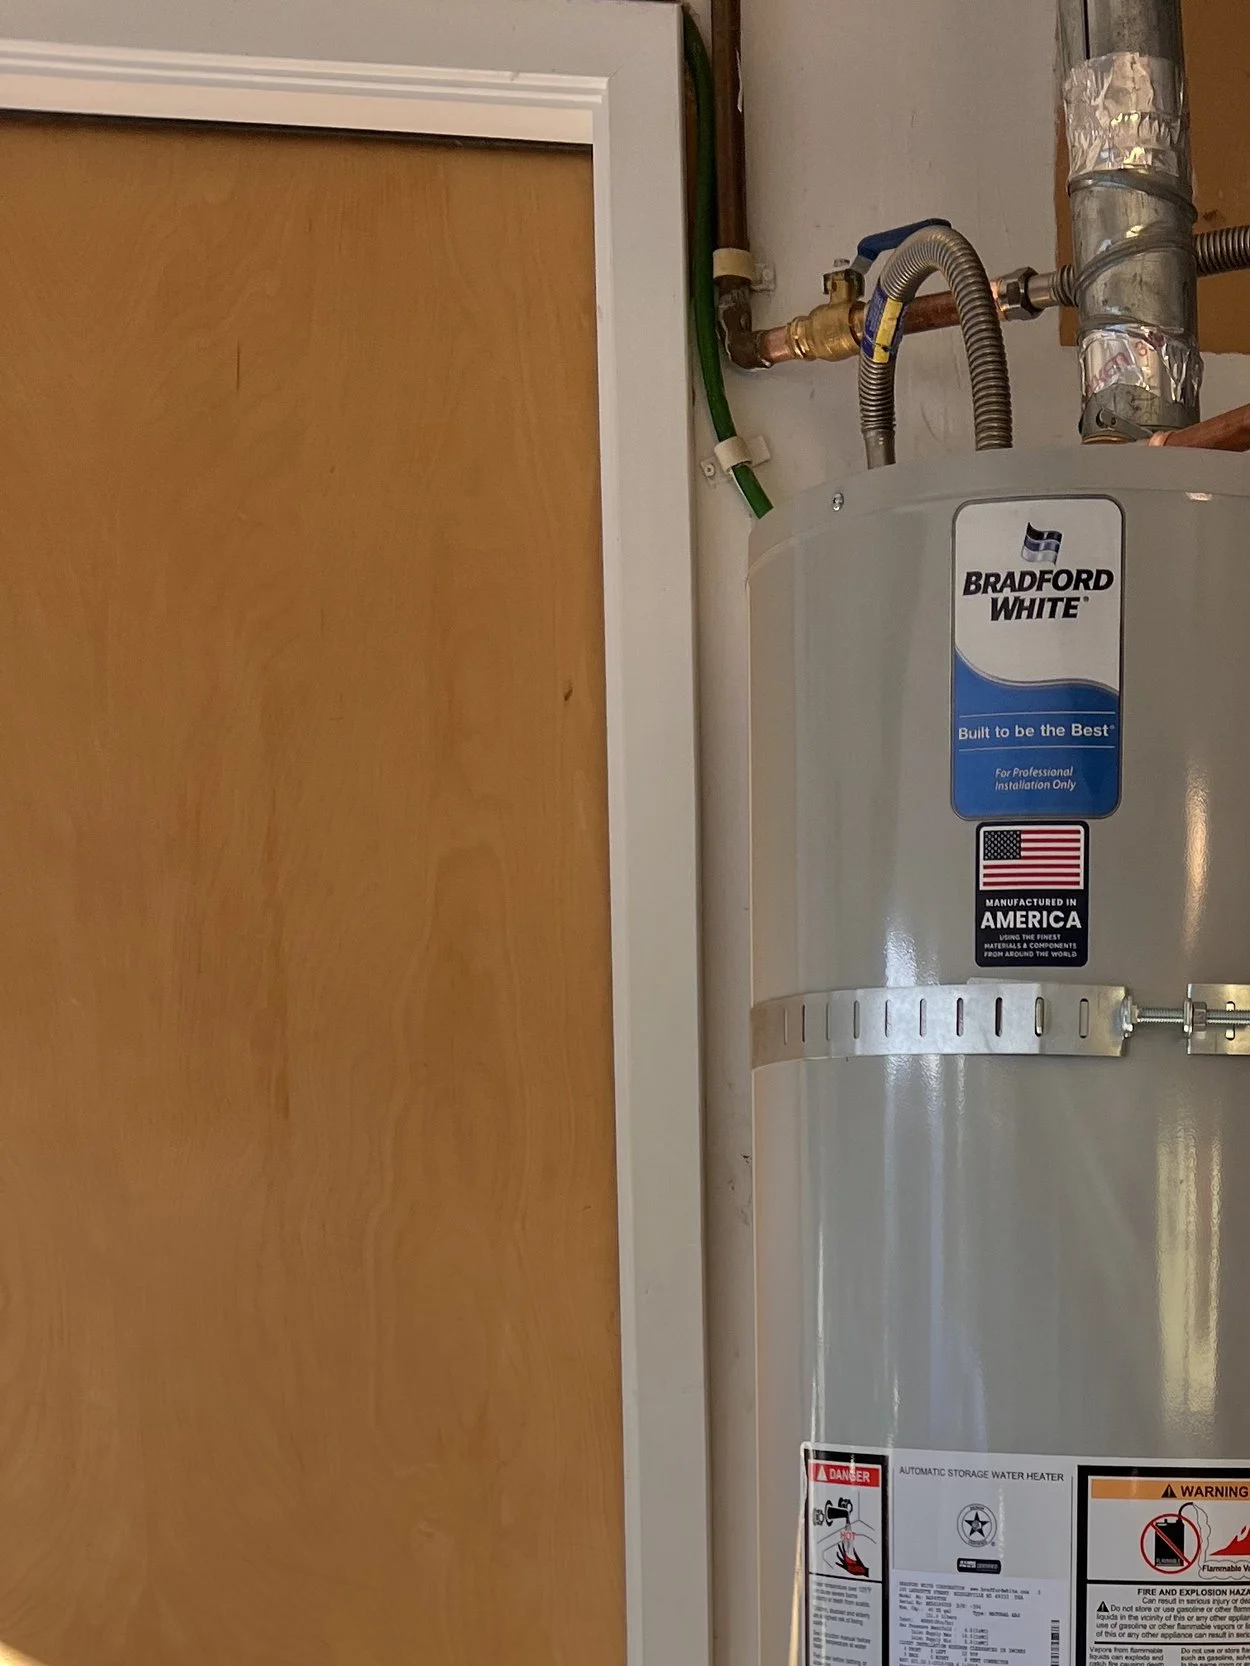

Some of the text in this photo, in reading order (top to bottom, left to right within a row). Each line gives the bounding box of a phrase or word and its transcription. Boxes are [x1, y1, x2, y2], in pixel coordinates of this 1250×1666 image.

[962, 567, 1114, 598] BRADFORD
[990, 594, 1080, 621] WHITE
[958, 722, 1110, 740] Built to be the Best
[995, 765, 1073, 778] For Professional
[994, 778, 1076, 792] Installation Only
[985, 897, 1076, 906] MANUFACTURED IN
[980, 910, 1081, 929] AMERICA
[999, 933, 1020, 941] USING
[829, 1467, 870, 1484] DANGER
[899, 1466, 1064, 1482] AUTOMATIC STORAGE WATER HEATER
[1180, 1485, 1248, 1498] WARNING
[839, 1530, 857, 1542] HOT
[1202, 1564, 1241, 1572] Flammable
[1137, 1588, 1156, 1596] FIRE
[1158, 1588, 1177, 1596] AND
[1179, 1588, 1227, 1596] EXPLOSION
[1185, 1597, 1210, 1605] serious
[1211, 1598, 1230, 1606] injury
[1230, 1598, 1238, 1606] or
[1110, 1604, 1121, 1614] Do
[1121, 1604, 1133, 1612] not
[1176, 1605, 1205, 1614] gasoline
[1214, 1603, 1231, 1613] other
[1096, 1613, 1118, 1623] liquids
[1127, 1613, 1139, 1621] the
[1140, 1614, 1163, 1623] vicinity
[1164, 1613, 1172, 1621] of
[1172, 1613, 1185, 1621] this
